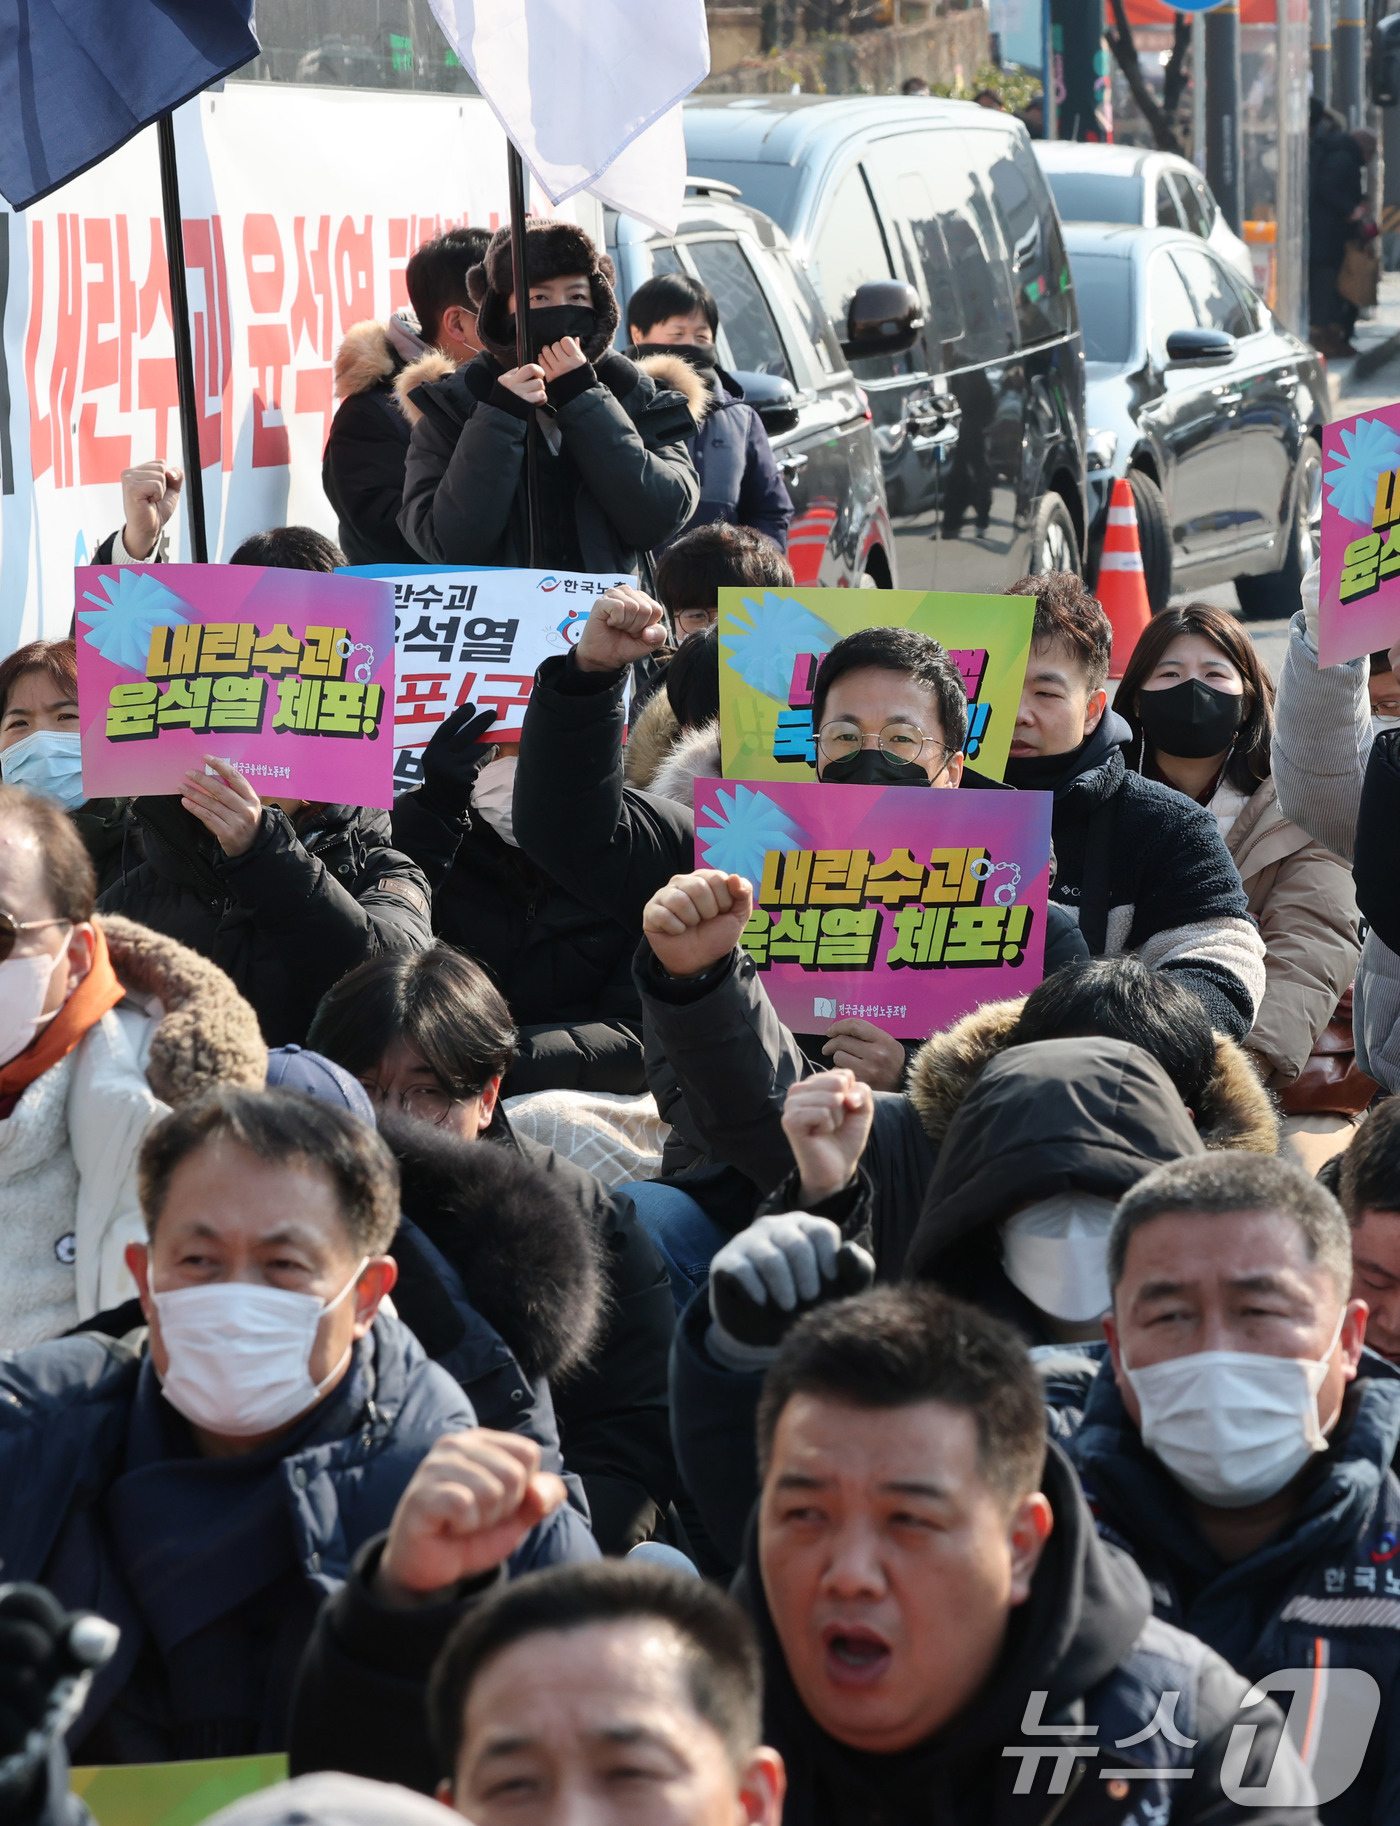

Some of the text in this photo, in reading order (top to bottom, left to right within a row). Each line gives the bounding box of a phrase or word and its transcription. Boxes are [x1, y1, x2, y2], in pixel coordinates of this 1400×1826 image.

[25, 213, 234, 489] 내란수괴
[145, 623, 353, 683] 내란수괴
[395, 614, 520, 664] 석열
[105, 676, 386, 743] 윤석열 체포!
[758, 847, 992, 909] 내란수괴
[886, 904, 1034, 970] 체포!
[839, 1003, 907, 1019] 전국금융산업노동조합
